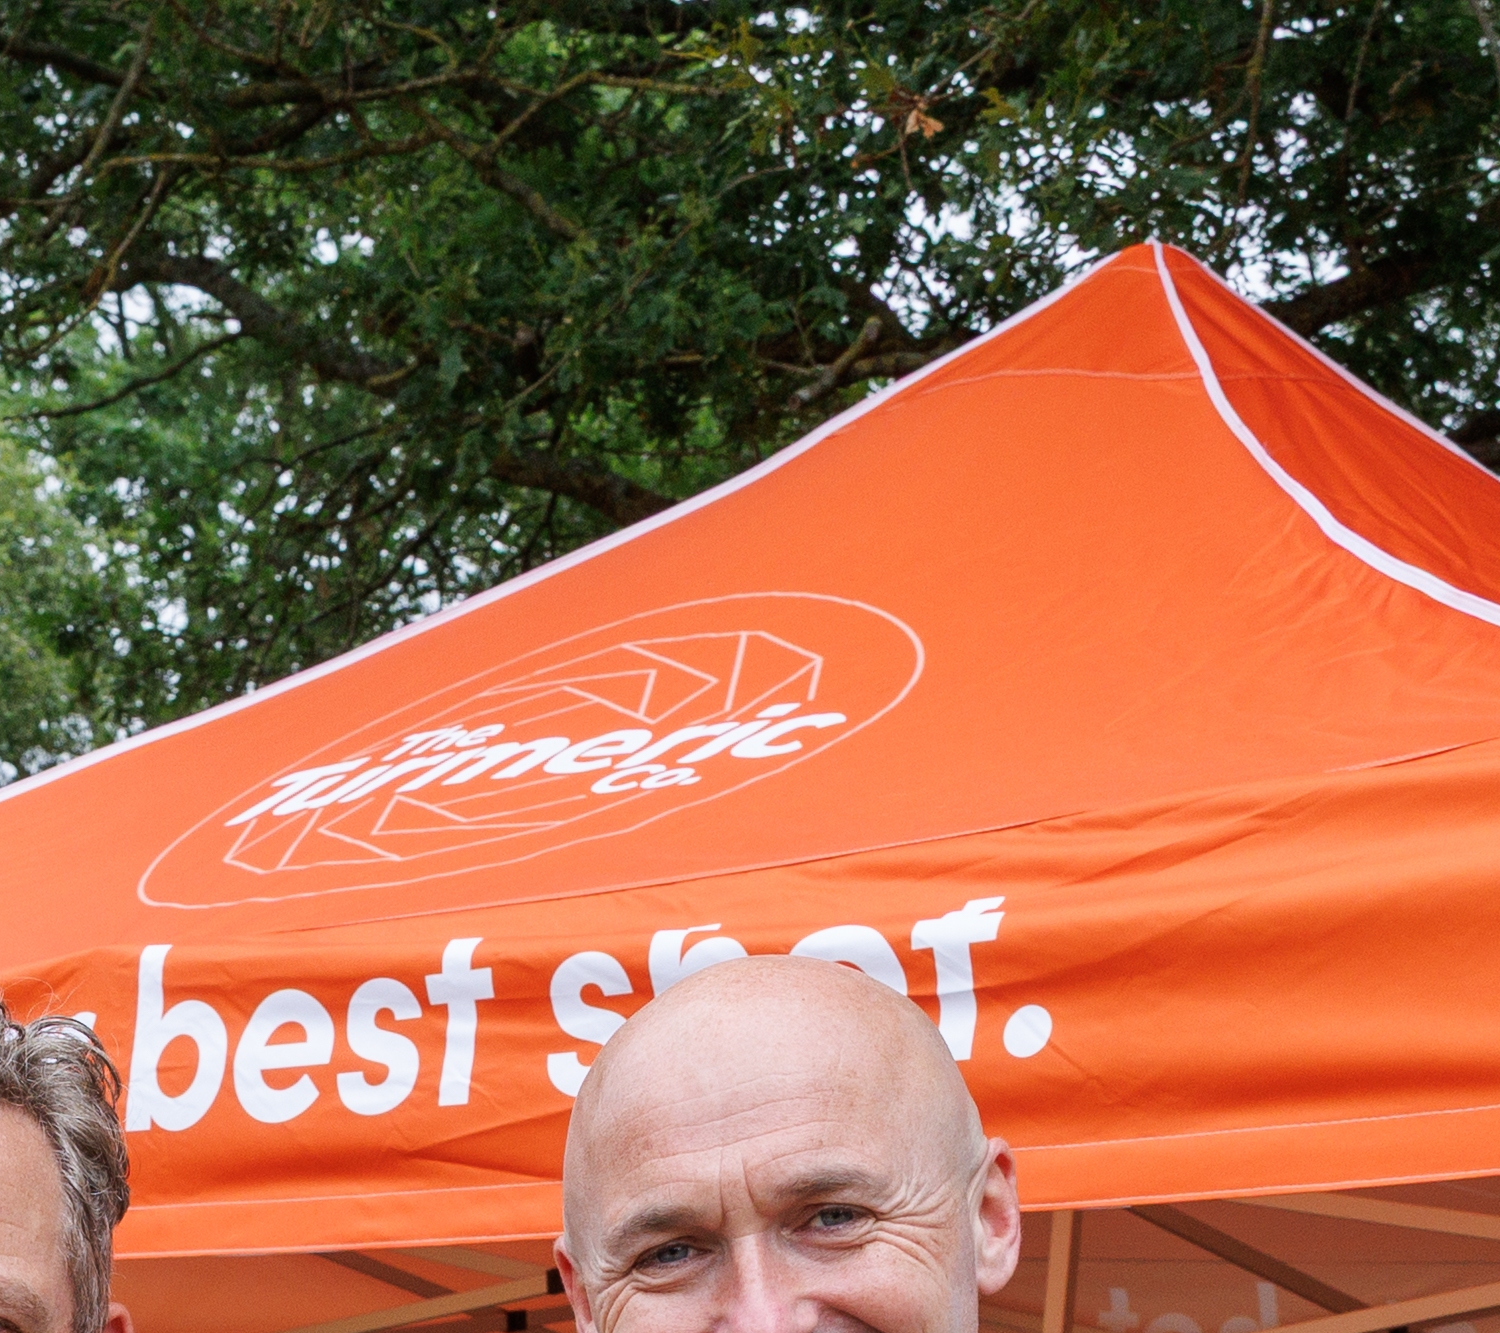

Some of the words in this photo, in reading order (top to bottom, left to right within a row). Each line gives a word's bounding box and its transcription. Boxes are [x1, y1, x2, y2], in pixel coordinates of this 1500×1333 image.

[225, 703, 846, 826] Turmeric
[381, 723, 505, 761] The
[590, 764, 702, 794] Co.
[126, 936, 494, 1133] best
